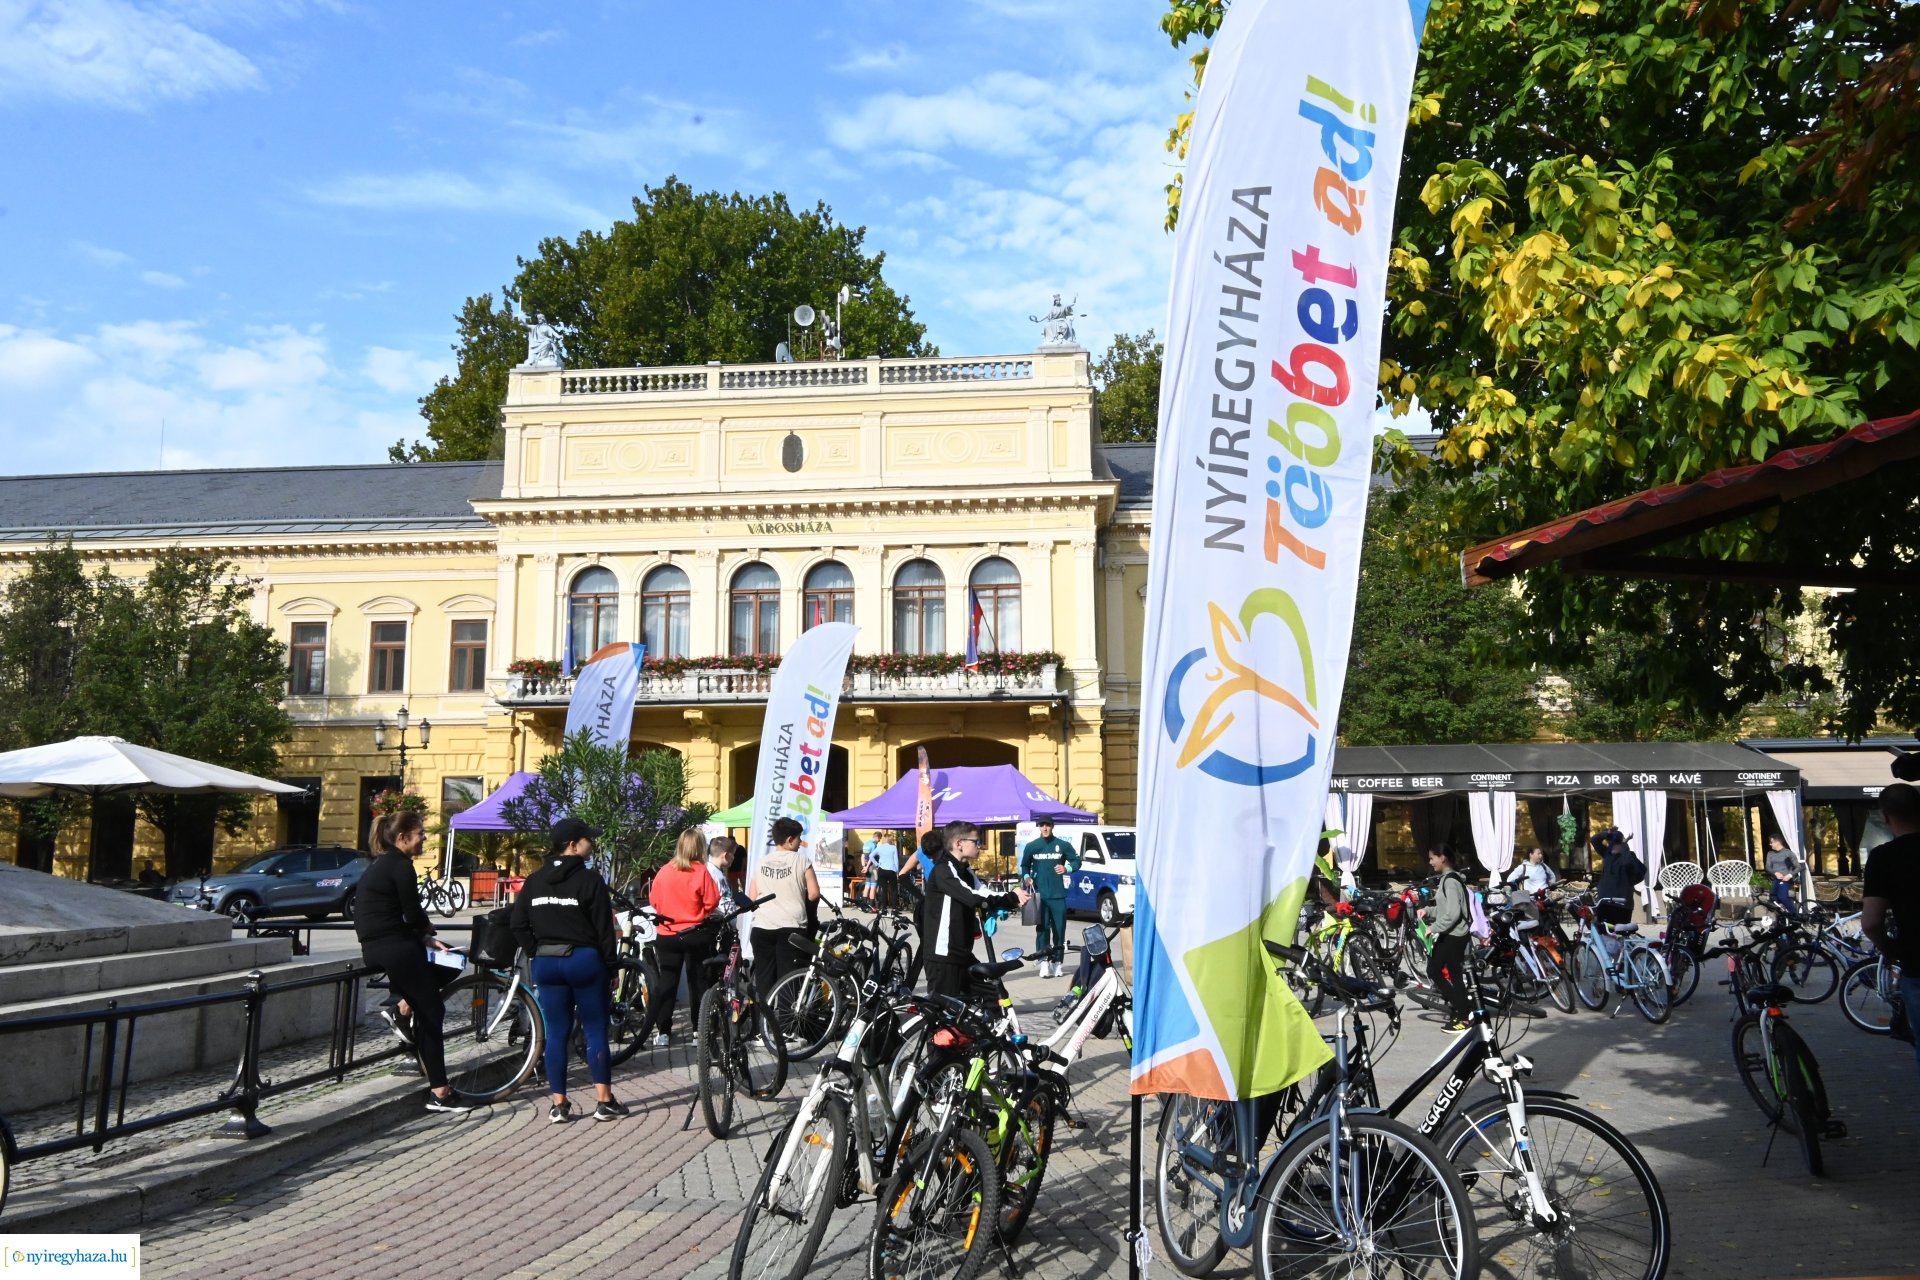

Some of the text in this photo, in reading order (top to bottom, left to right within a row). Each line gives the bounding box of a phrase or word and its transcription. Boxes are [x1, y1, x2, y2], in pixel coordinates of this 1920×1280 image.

[1264, 73, 1378, 571] Többet ad!
[1196, 184, 1272, 554] NYÍREGYHÁZA
[747, 520, 833, 535] VÁROSHÁZA
[594, 676, 617, 748] YHÁZA
[787, 683, 832, 849] öbbet ad!
[1331, 777, 1444, 788] INE COFFEE BEER
[1546, 772, 1702, 785] PIZZA BOR SÖR KÁVÉ
[1737, 772, 1782, 780] CONTINENT
[760, 865, 793, 880] NEW YORK
